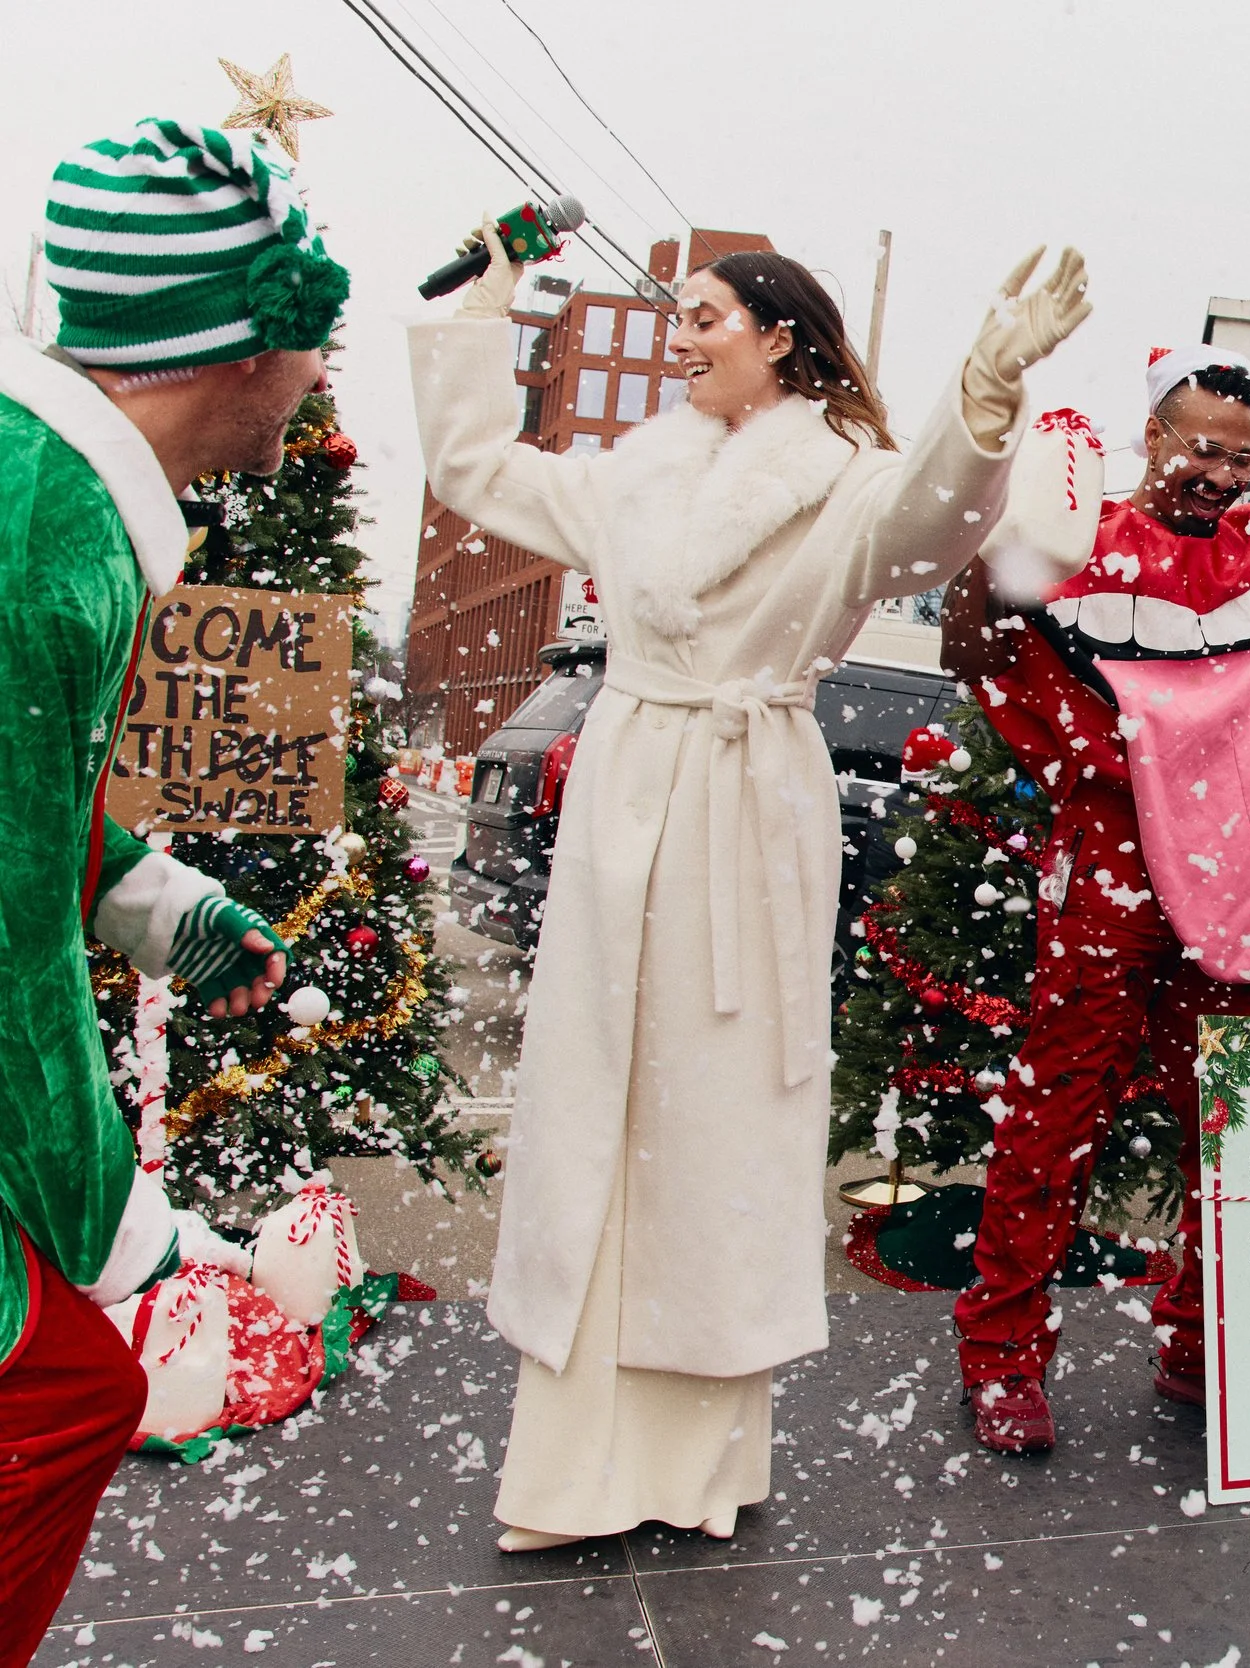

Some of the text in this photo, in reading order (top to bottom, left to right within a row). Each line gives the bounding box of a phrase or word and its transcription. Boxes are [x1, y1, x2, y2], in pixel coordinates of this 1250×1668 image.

[581, 624, 599, 634] FOR
[156, 671, 248, 723] THE
[156, 782, 311, 826] SWOLE
